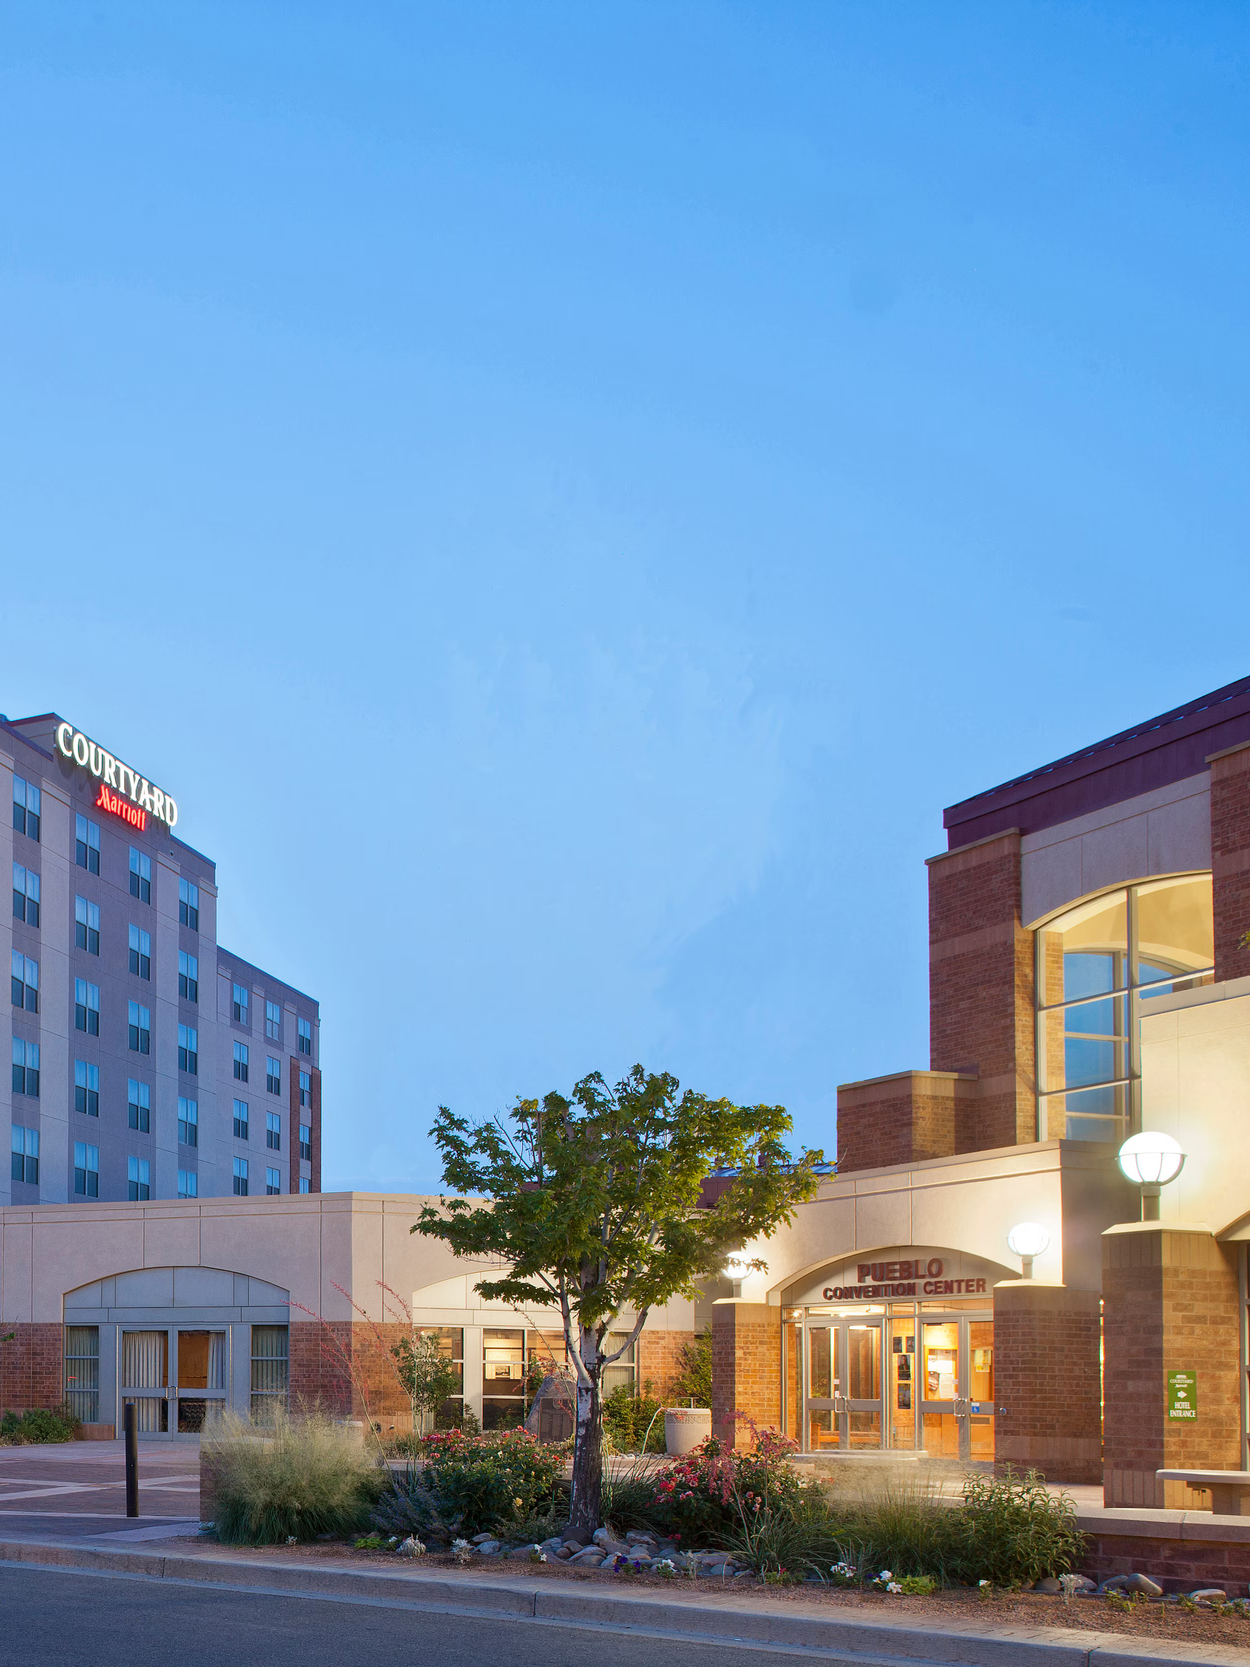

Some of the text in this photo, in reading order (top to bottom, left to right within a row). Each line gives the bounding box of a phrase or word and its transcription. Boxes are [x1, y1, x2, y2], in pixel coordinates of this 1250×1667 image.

[58, 722, 178, 827] COURTYARD
[96, 784, 146, 831] Marriott
[857, 1258, 944, 1283] PUEBLO
[822, 1278, 987, 1300] CONVENTION CENTER
[1169, 1409, 1196, 1418] ENTRANCE
[1174, 1401, 1191, 1409] HOTEL
